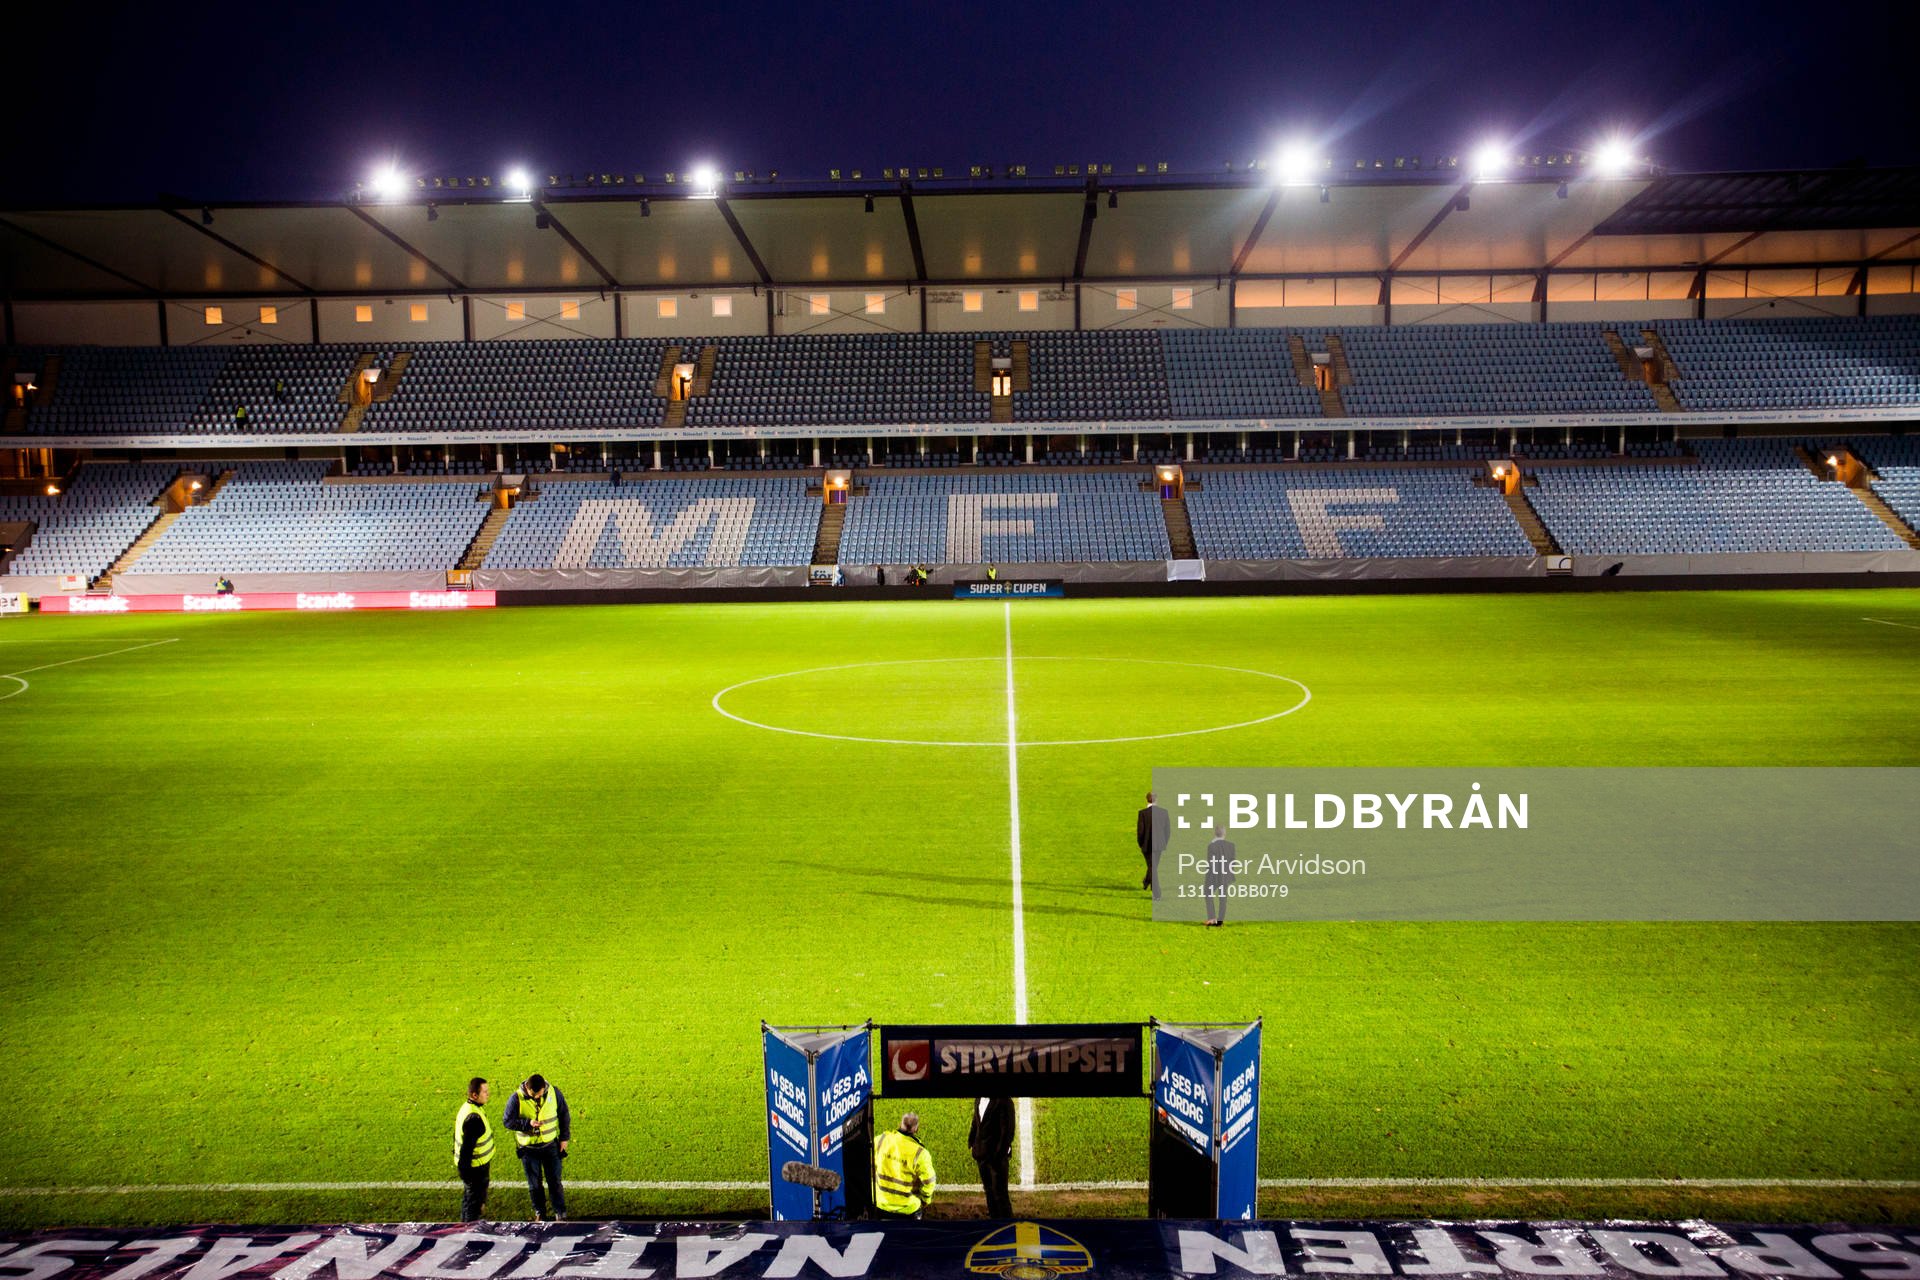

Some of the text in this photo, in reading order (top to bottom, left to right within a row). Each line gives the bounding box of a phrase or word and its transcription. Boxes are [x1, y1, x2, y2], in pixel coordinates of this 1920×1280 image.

[183, 594, 242, 610] Scandic
[296, 592, 355, 608] Scandic
[409, 591, 468, 607] Scandic
[970, 583, 1047, 594] SUPER CUPEN
[941, 1044, 1130, 1073] STRYKTIPSET
[780, 1074, 794, 1099] SES
[796, 1087, 806, 1109] PÅ
[833, 1077, 852, 1100] SES
[854, 1064, 868, 1089] PÅ
[1172, 1072, 1191, 1096] SES
[1194, 1083, 1208, 1107] PÅ
[1231, 1072, 1245, 1097] SES
[1245, 1060, 1255, 1085] PÅ
[775, 1090, 804, 1127] LÖRDAG
[826, 1090, 861, 1126] LÖRDAG
[1164, 1087, 1203, 1125] LÖRDAG
